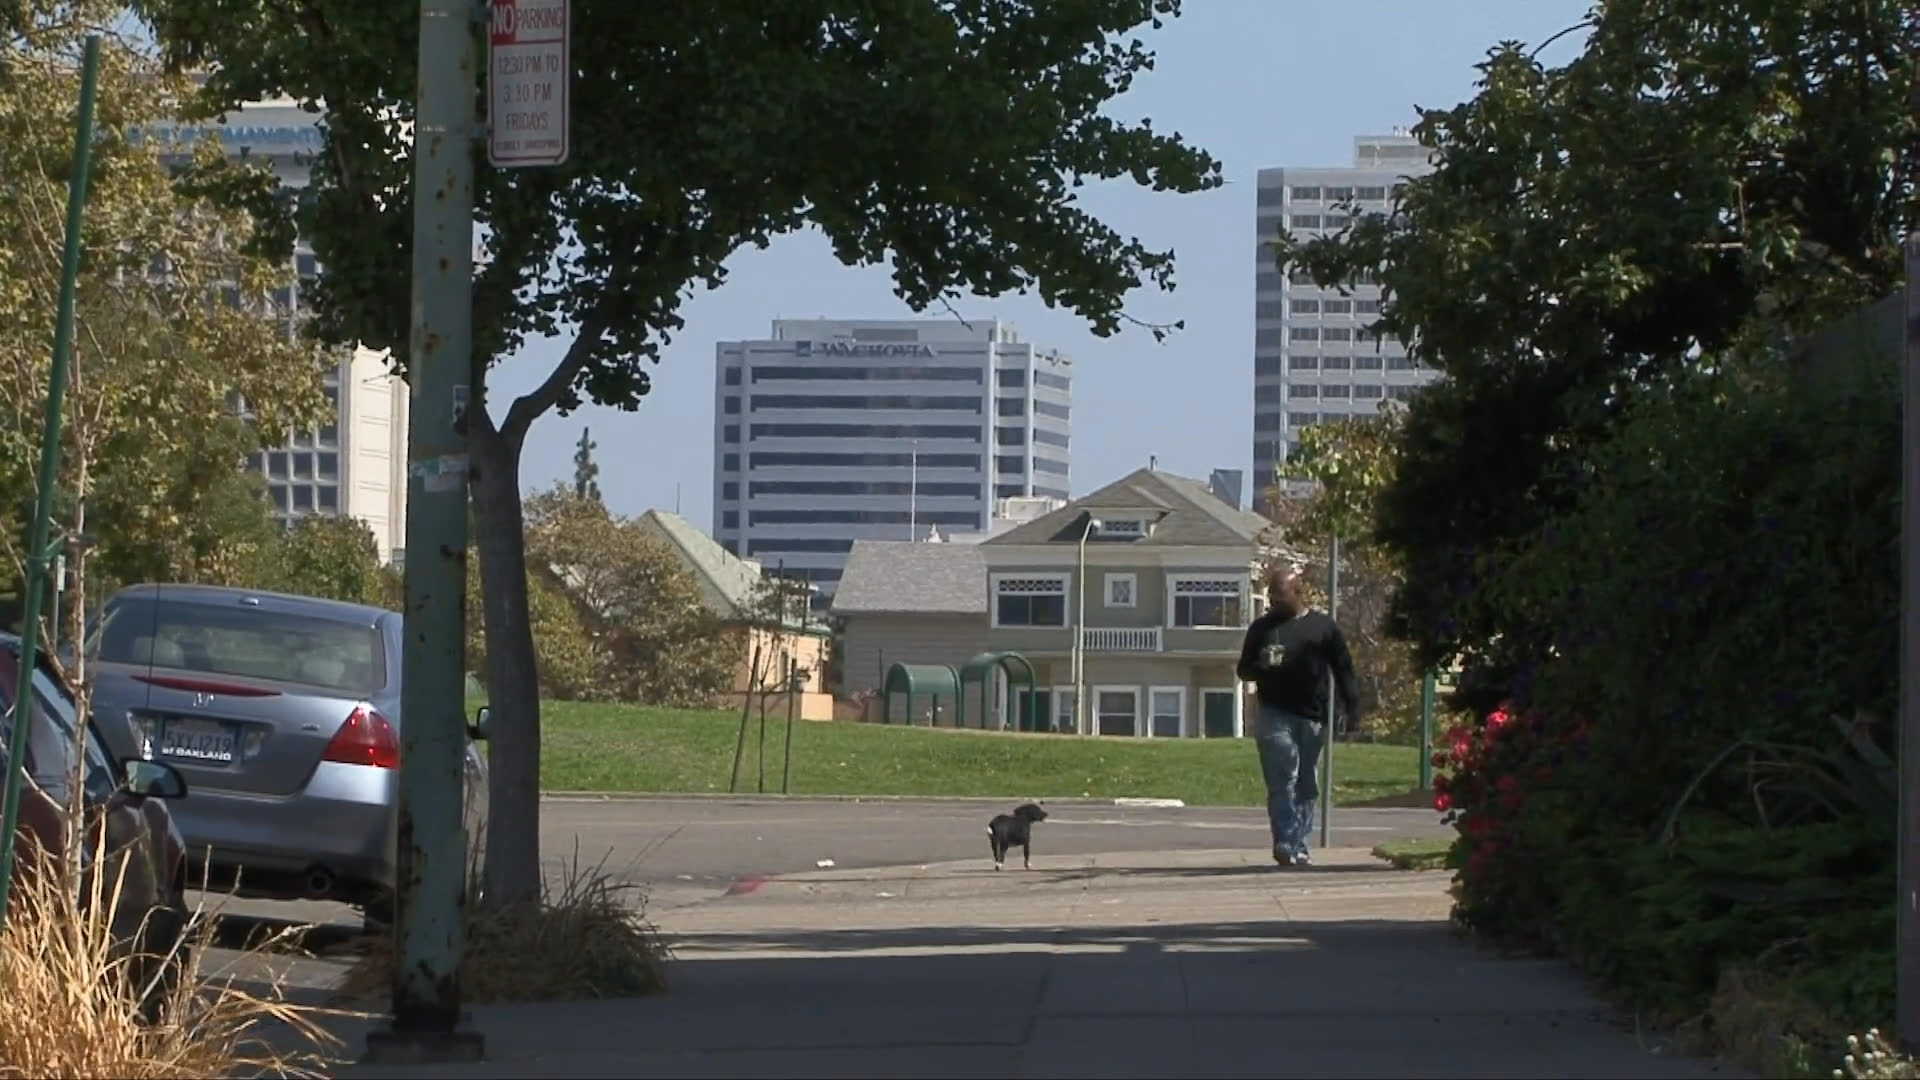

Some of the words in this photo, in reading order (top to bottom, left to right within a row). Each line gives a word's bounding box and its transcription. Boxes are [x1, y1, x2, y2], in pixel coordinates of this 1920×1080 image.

[492, 4, 515, 35] NO
[516, 7, 563, 31] PARKING
[525, 55, 541, 73] PM
[546, 53, 559, 73] TO
[534, 83, 551, 103] PM
[505, 112, 548, 131] FRIDAYS
[175, 747, 232, 761] OAKLAND
